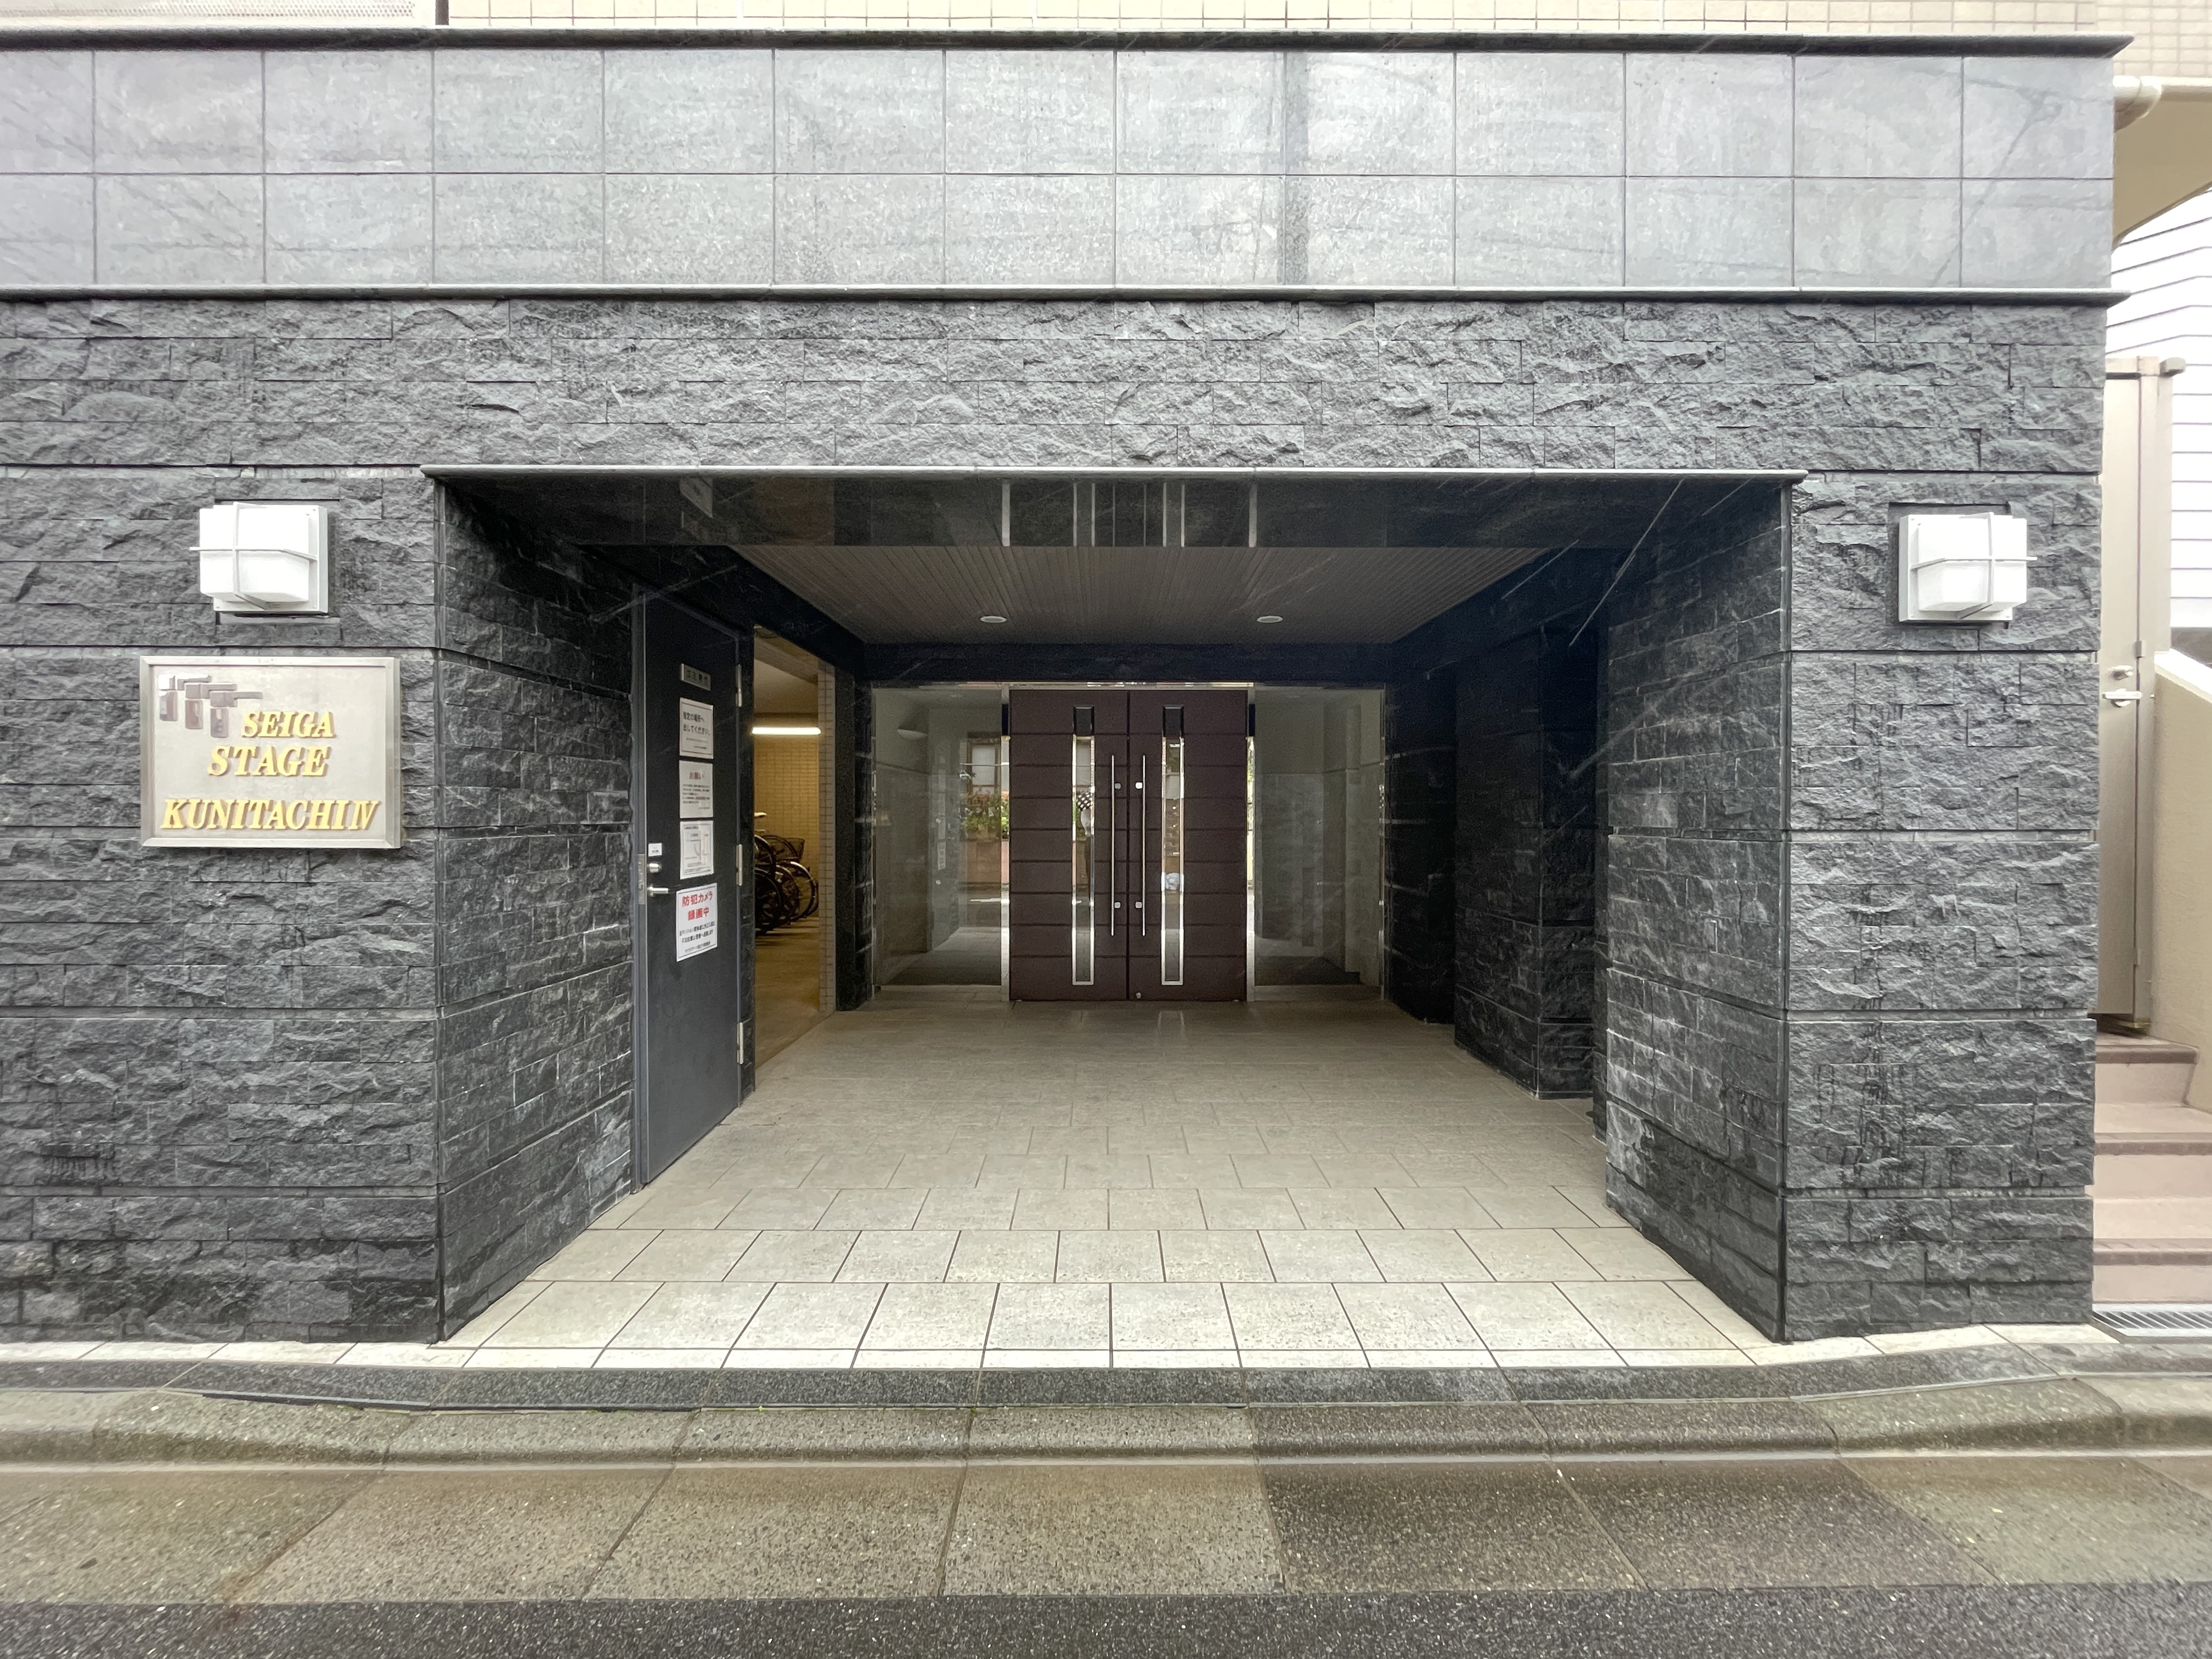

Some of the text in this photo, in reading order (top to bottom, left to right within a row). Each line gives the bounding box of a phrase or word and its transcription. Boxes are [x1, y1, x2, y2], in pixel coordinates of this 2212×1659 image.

[241, 711, 335, 738] SEIGA
[207, 747, 330, 777] STAGE
[682, 891, 713, 907] 防犯カメラ
